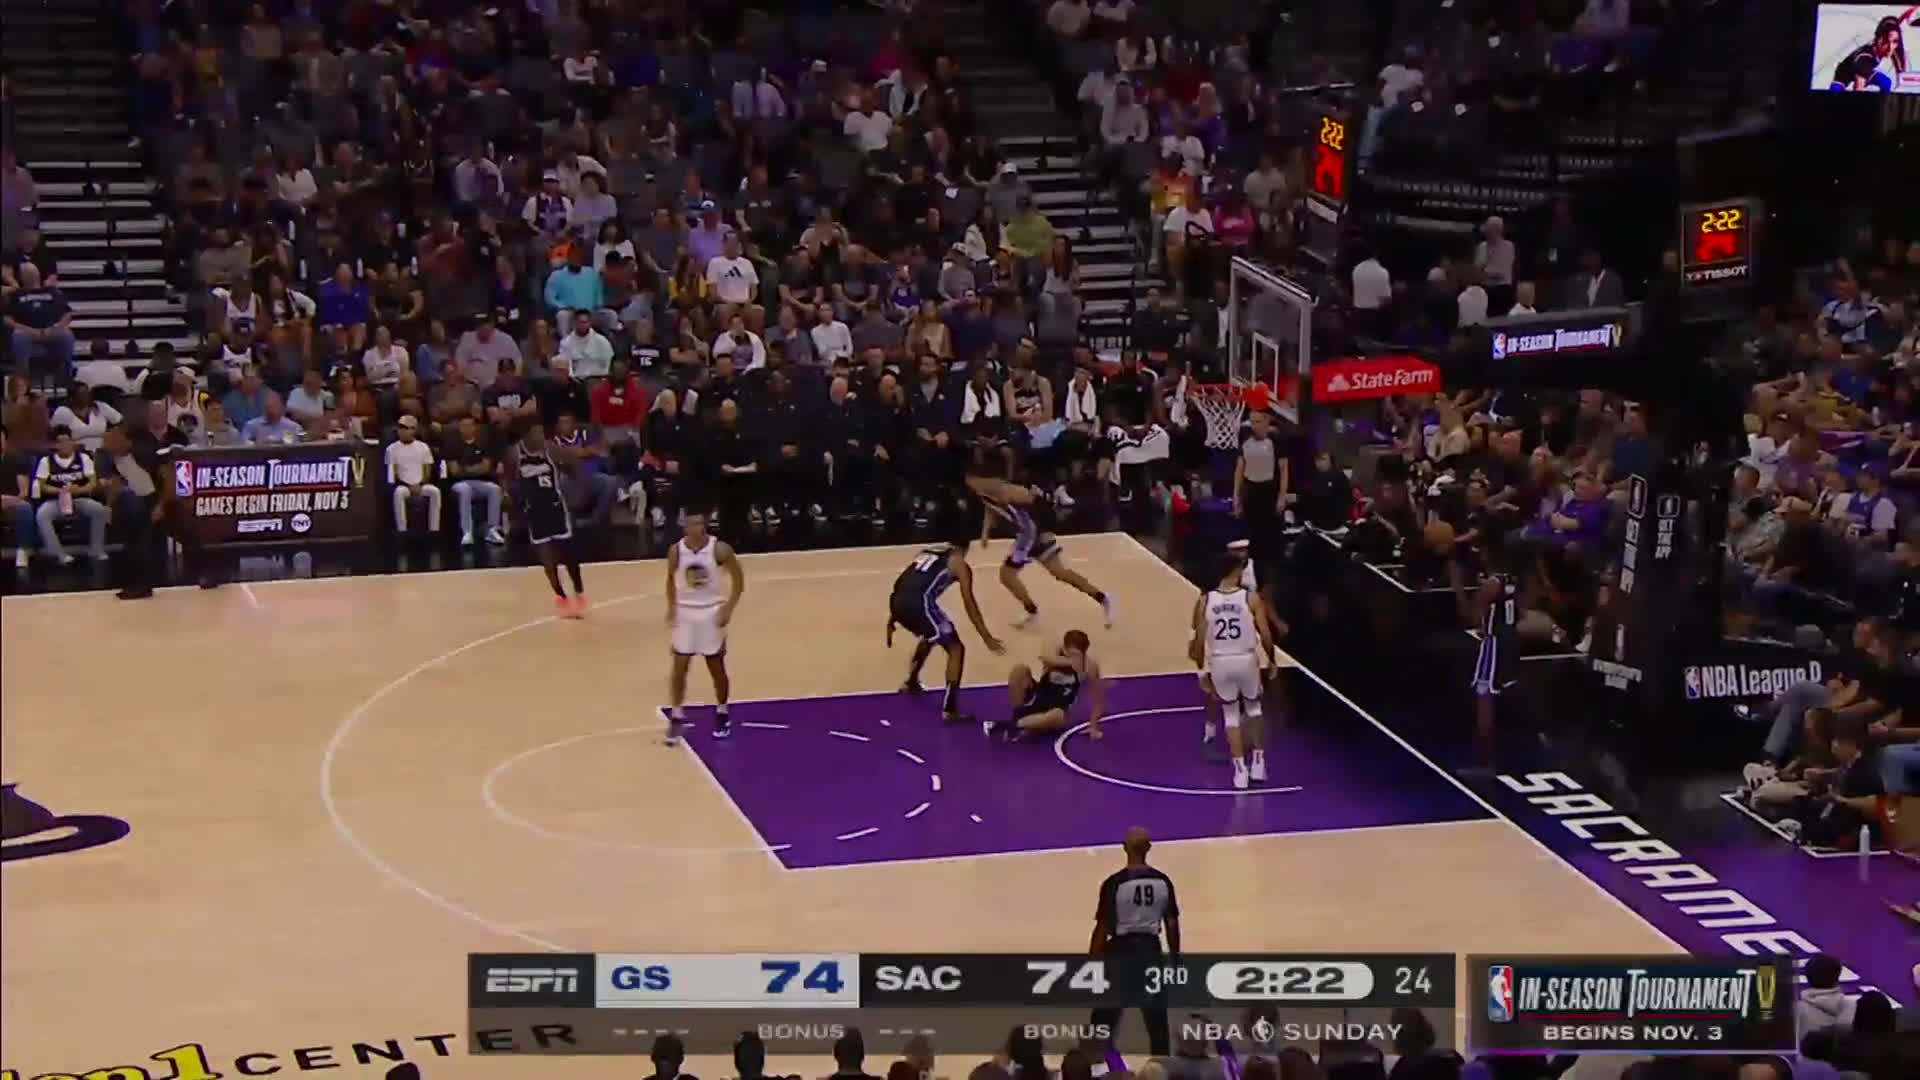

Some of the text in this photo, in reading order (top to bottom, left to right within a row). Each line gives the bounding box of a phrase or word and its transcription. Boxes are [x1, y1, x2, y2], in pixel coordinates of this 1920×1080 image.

[196, 456, 352, 491] IN-SEASON TOURNAMENT
[196, 496, 234, 516] GAMES
[235, 493, 268, 514] BEGIN
[314, 491, 340, 510] NOV
[339, 489, 350, 509] 3
[237, 518, 284, 533] ESPN
[1215, 618, 1242, 641] 25
[1701, 665, 1739, 697] NBA
[1133, 884, 1155, 907] 49
[1496, 771, 1904, 1010] SACRAME
[233, 1022, 578, 1077] CENTER
